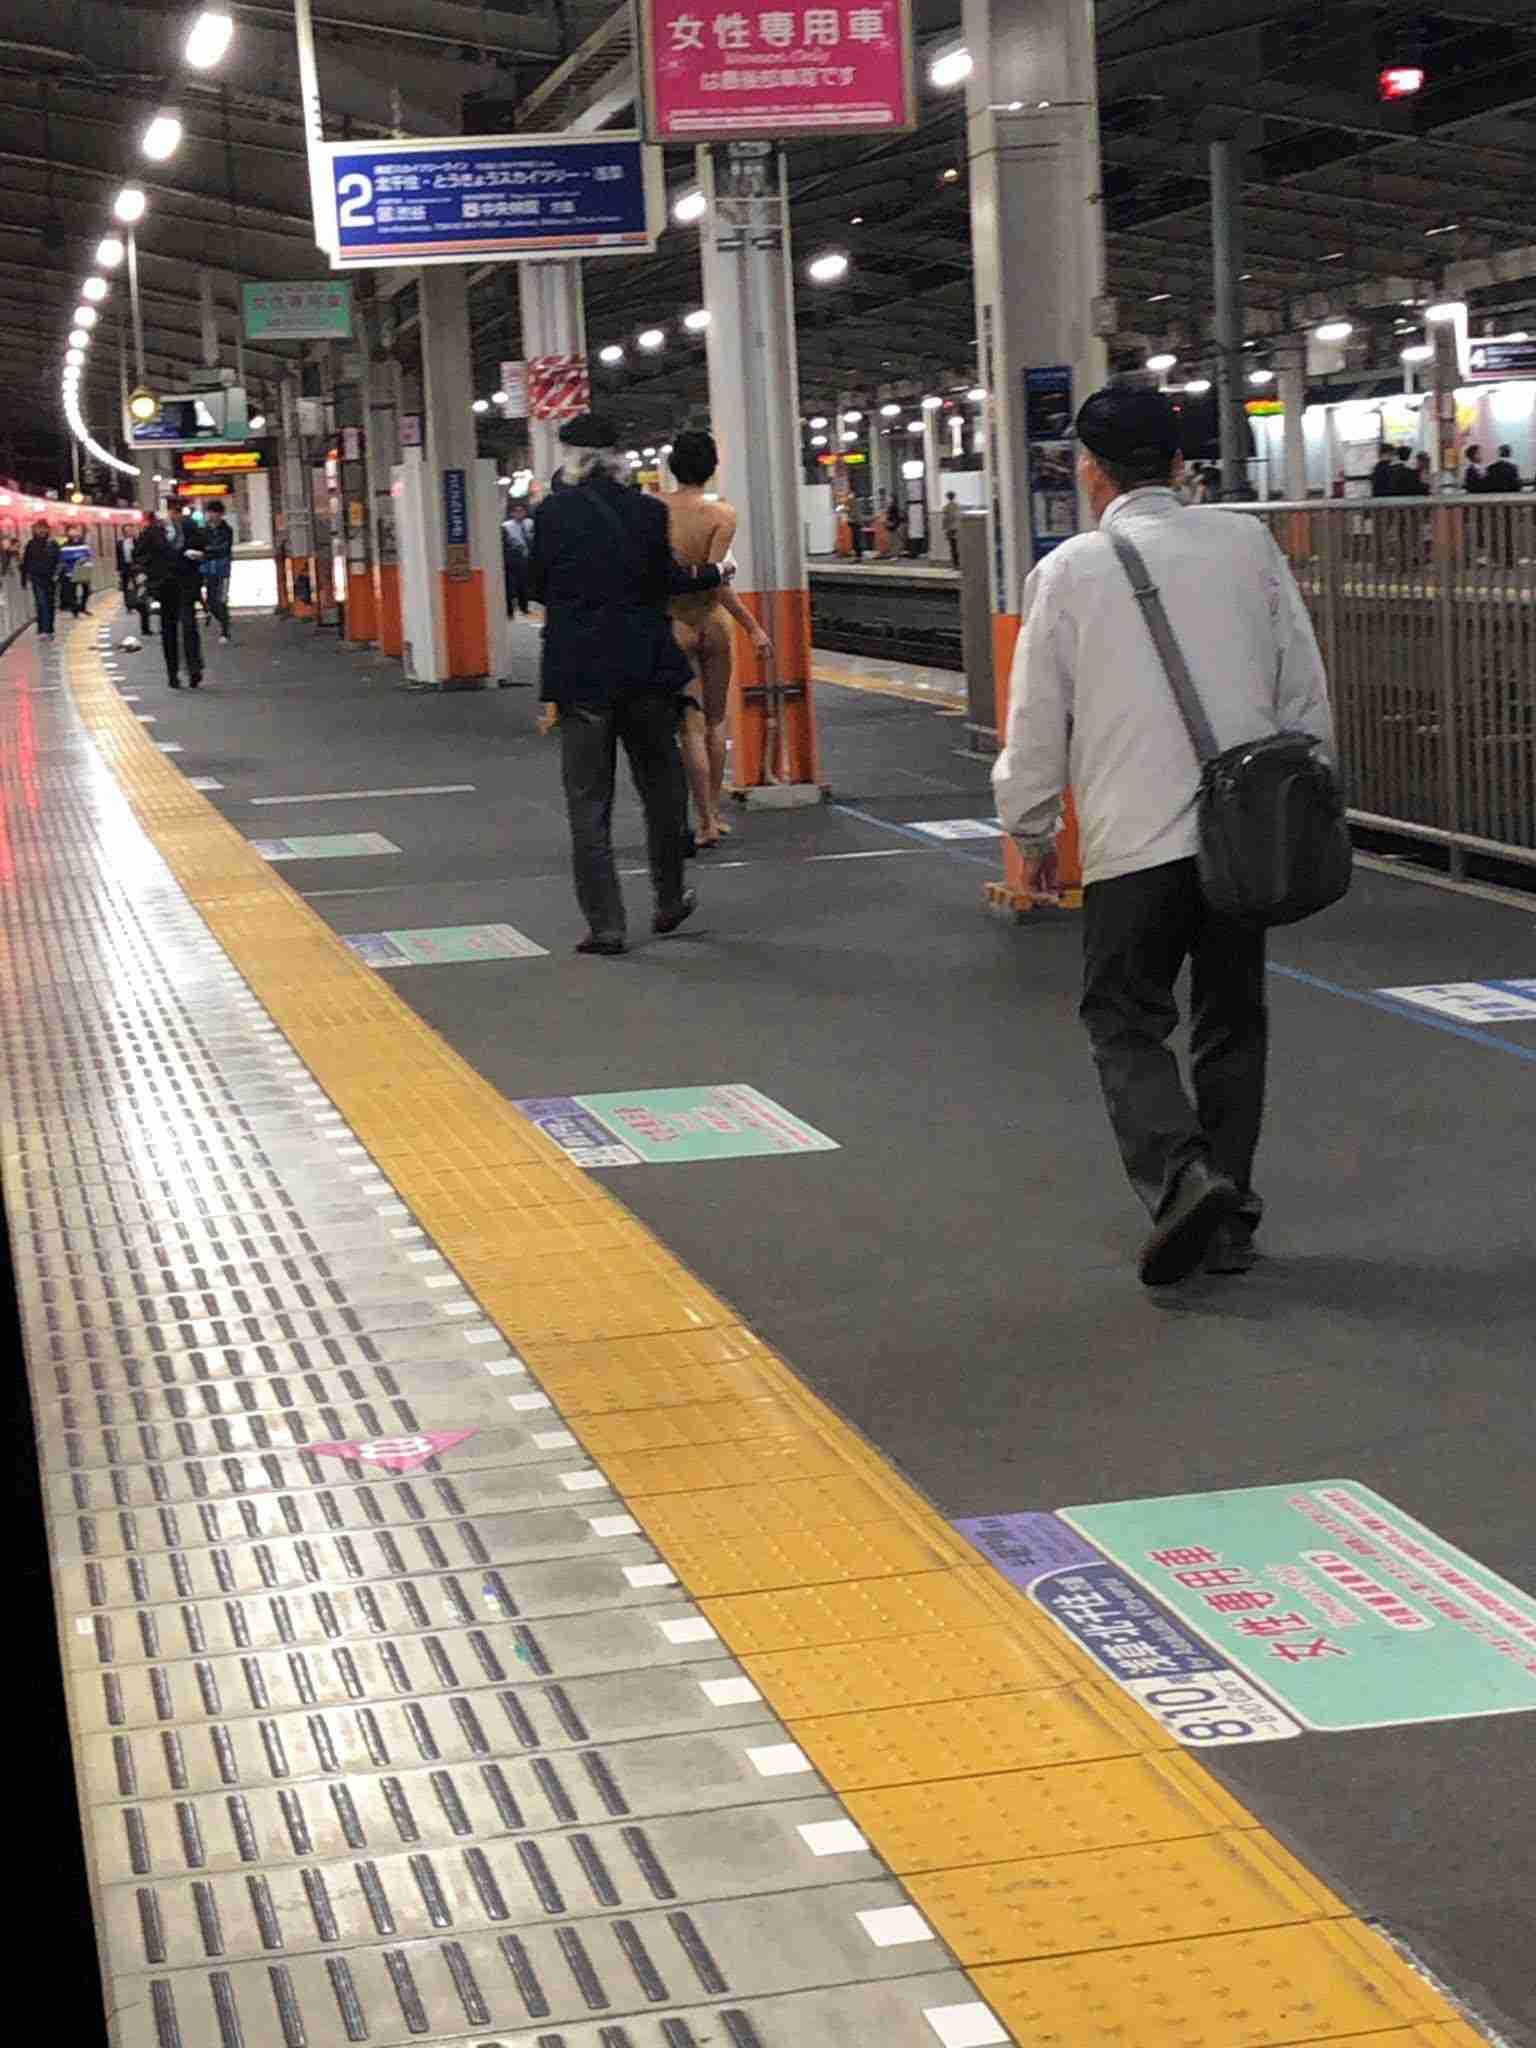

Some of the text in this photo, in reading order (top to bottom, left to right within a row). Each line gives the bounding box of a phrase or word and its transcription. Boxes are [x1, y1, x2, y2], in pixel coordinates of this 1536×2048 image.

[667, 8, 885, 51] 女性専用車
[338, 173, 375, 227] 2
[1149, 1544, 1351, 1664] 女性専用車
